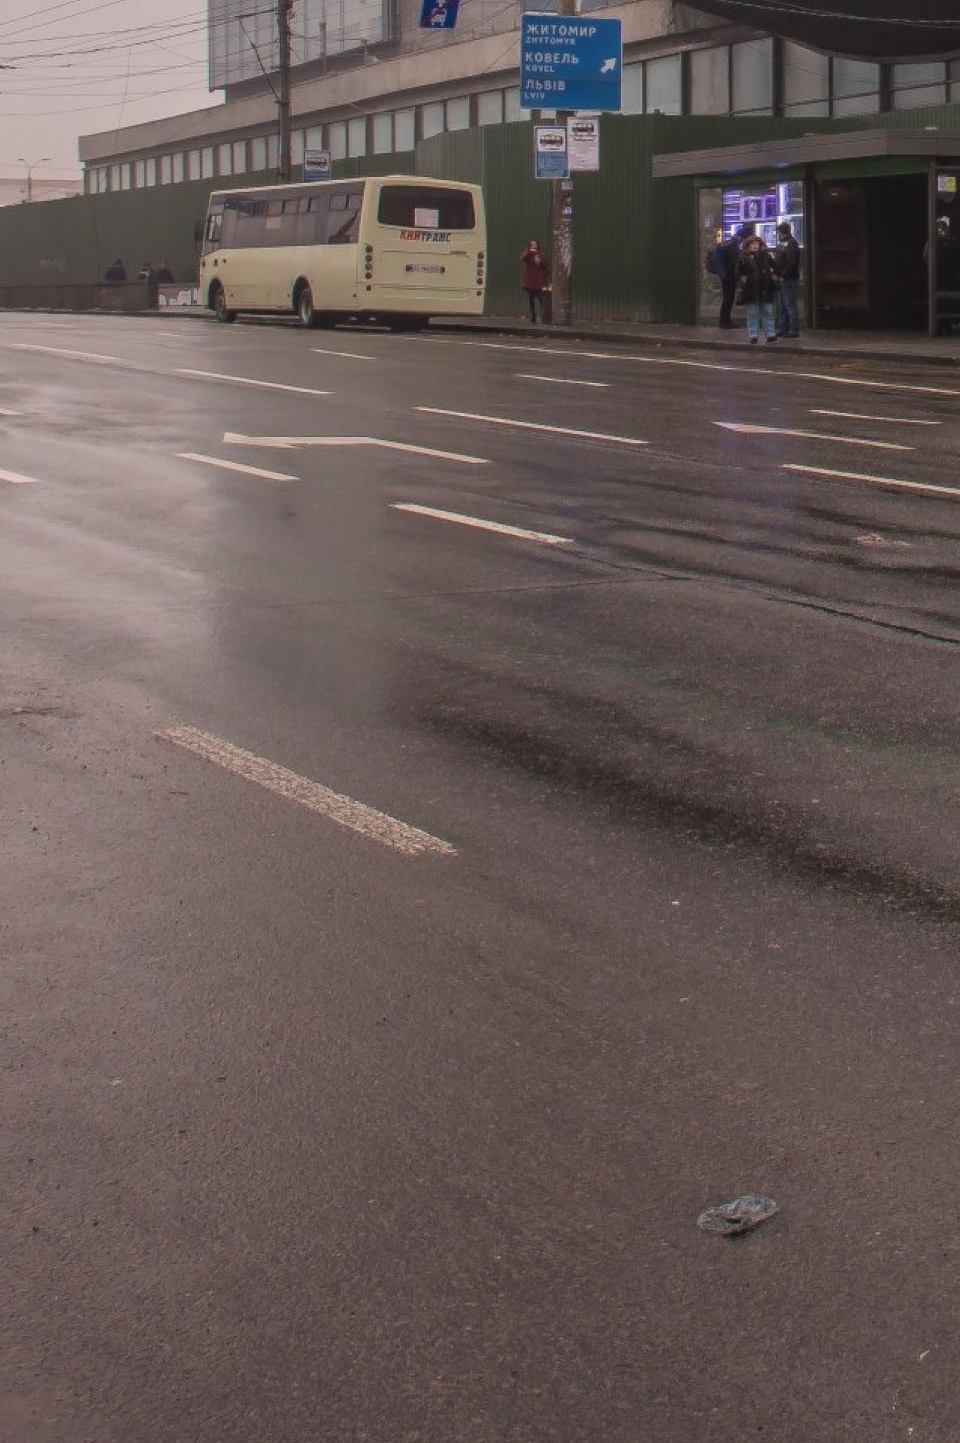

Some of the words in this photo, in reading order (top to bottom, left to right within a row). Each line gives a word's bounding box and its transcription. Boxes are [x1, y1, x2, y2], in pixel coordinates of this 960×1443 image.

[527, 24, 597, 37] ЖИТОМИР
[525, 36, 576, 46] ZHYTOMYR
[525, 52, 579, 65] КОВЕЛЬ
[525, 64, 555, 73] KOVEL
[525, 79, 566, 90] ЛЬВІВ
[524, 92, 545, 100] LVIV
